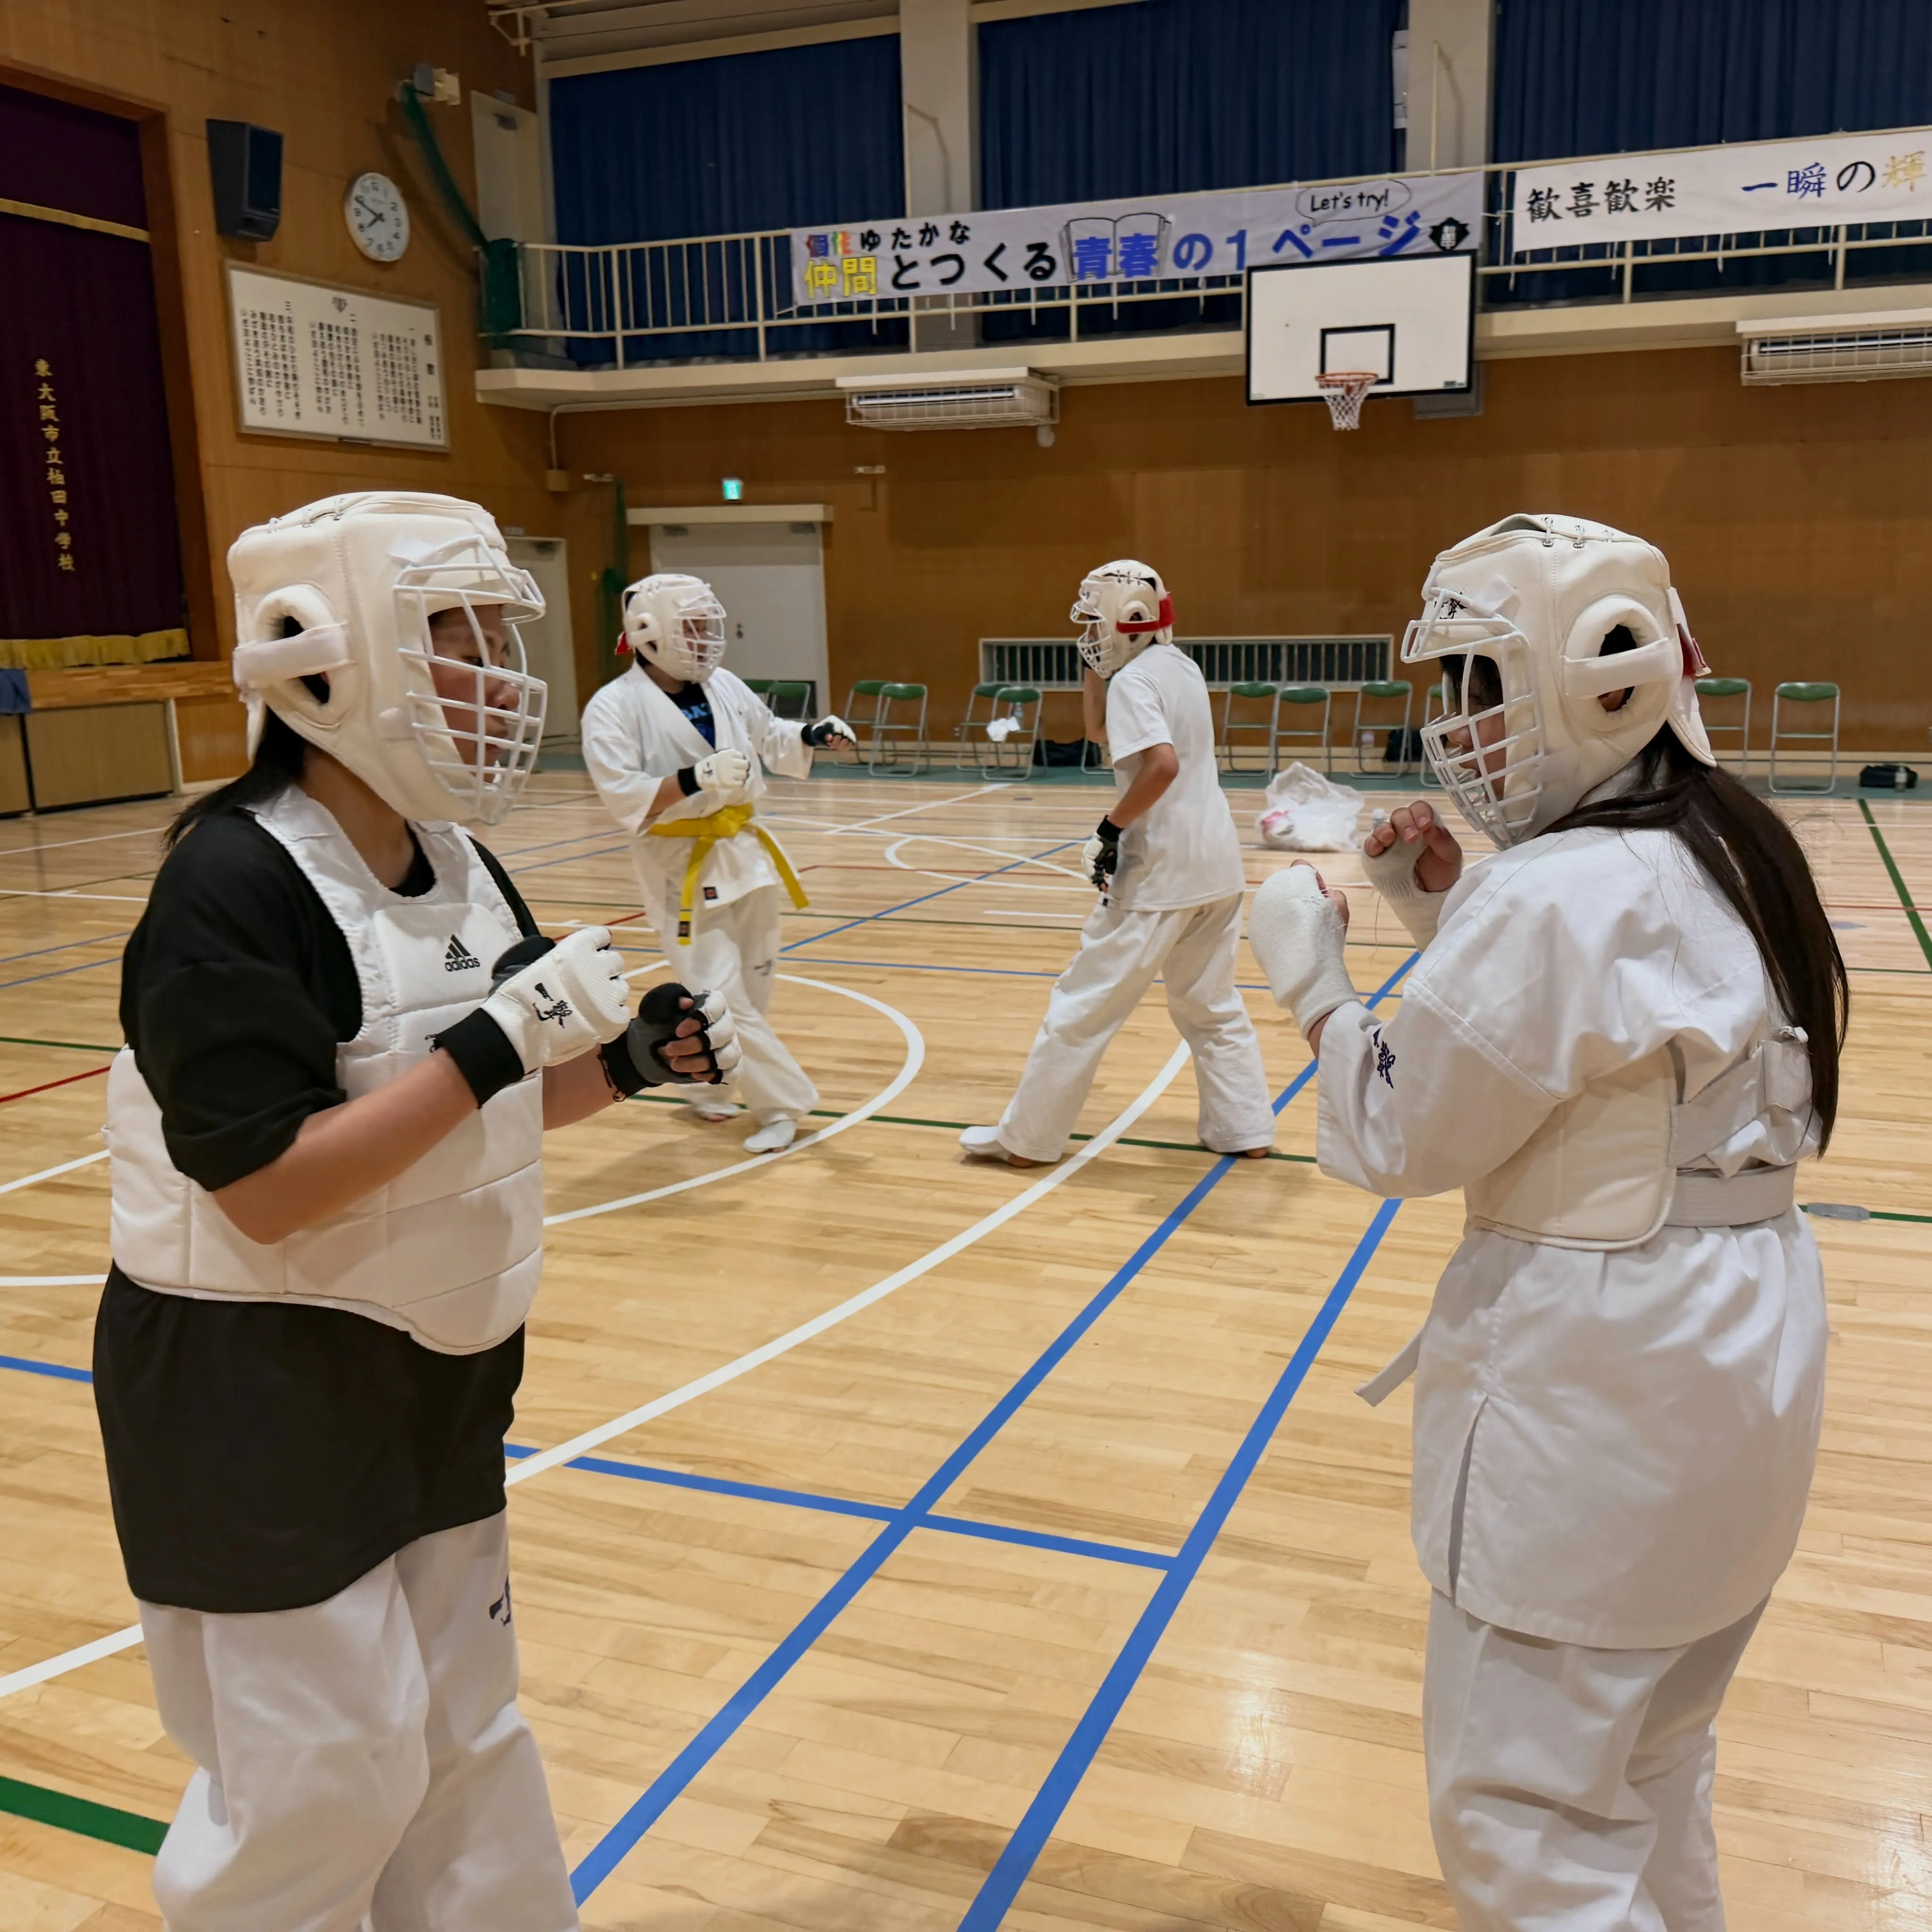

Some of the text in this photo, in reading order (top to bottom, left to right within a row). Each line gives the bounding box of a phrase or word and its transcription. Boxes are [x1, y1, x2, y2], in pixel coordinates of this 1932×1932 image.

[1527, 151, 1927, 223] 歓喜歓楽 一瞬の輝
[1311, 188, 1388, 212] Let's try!
[445, 957, 481, 972] adidas
